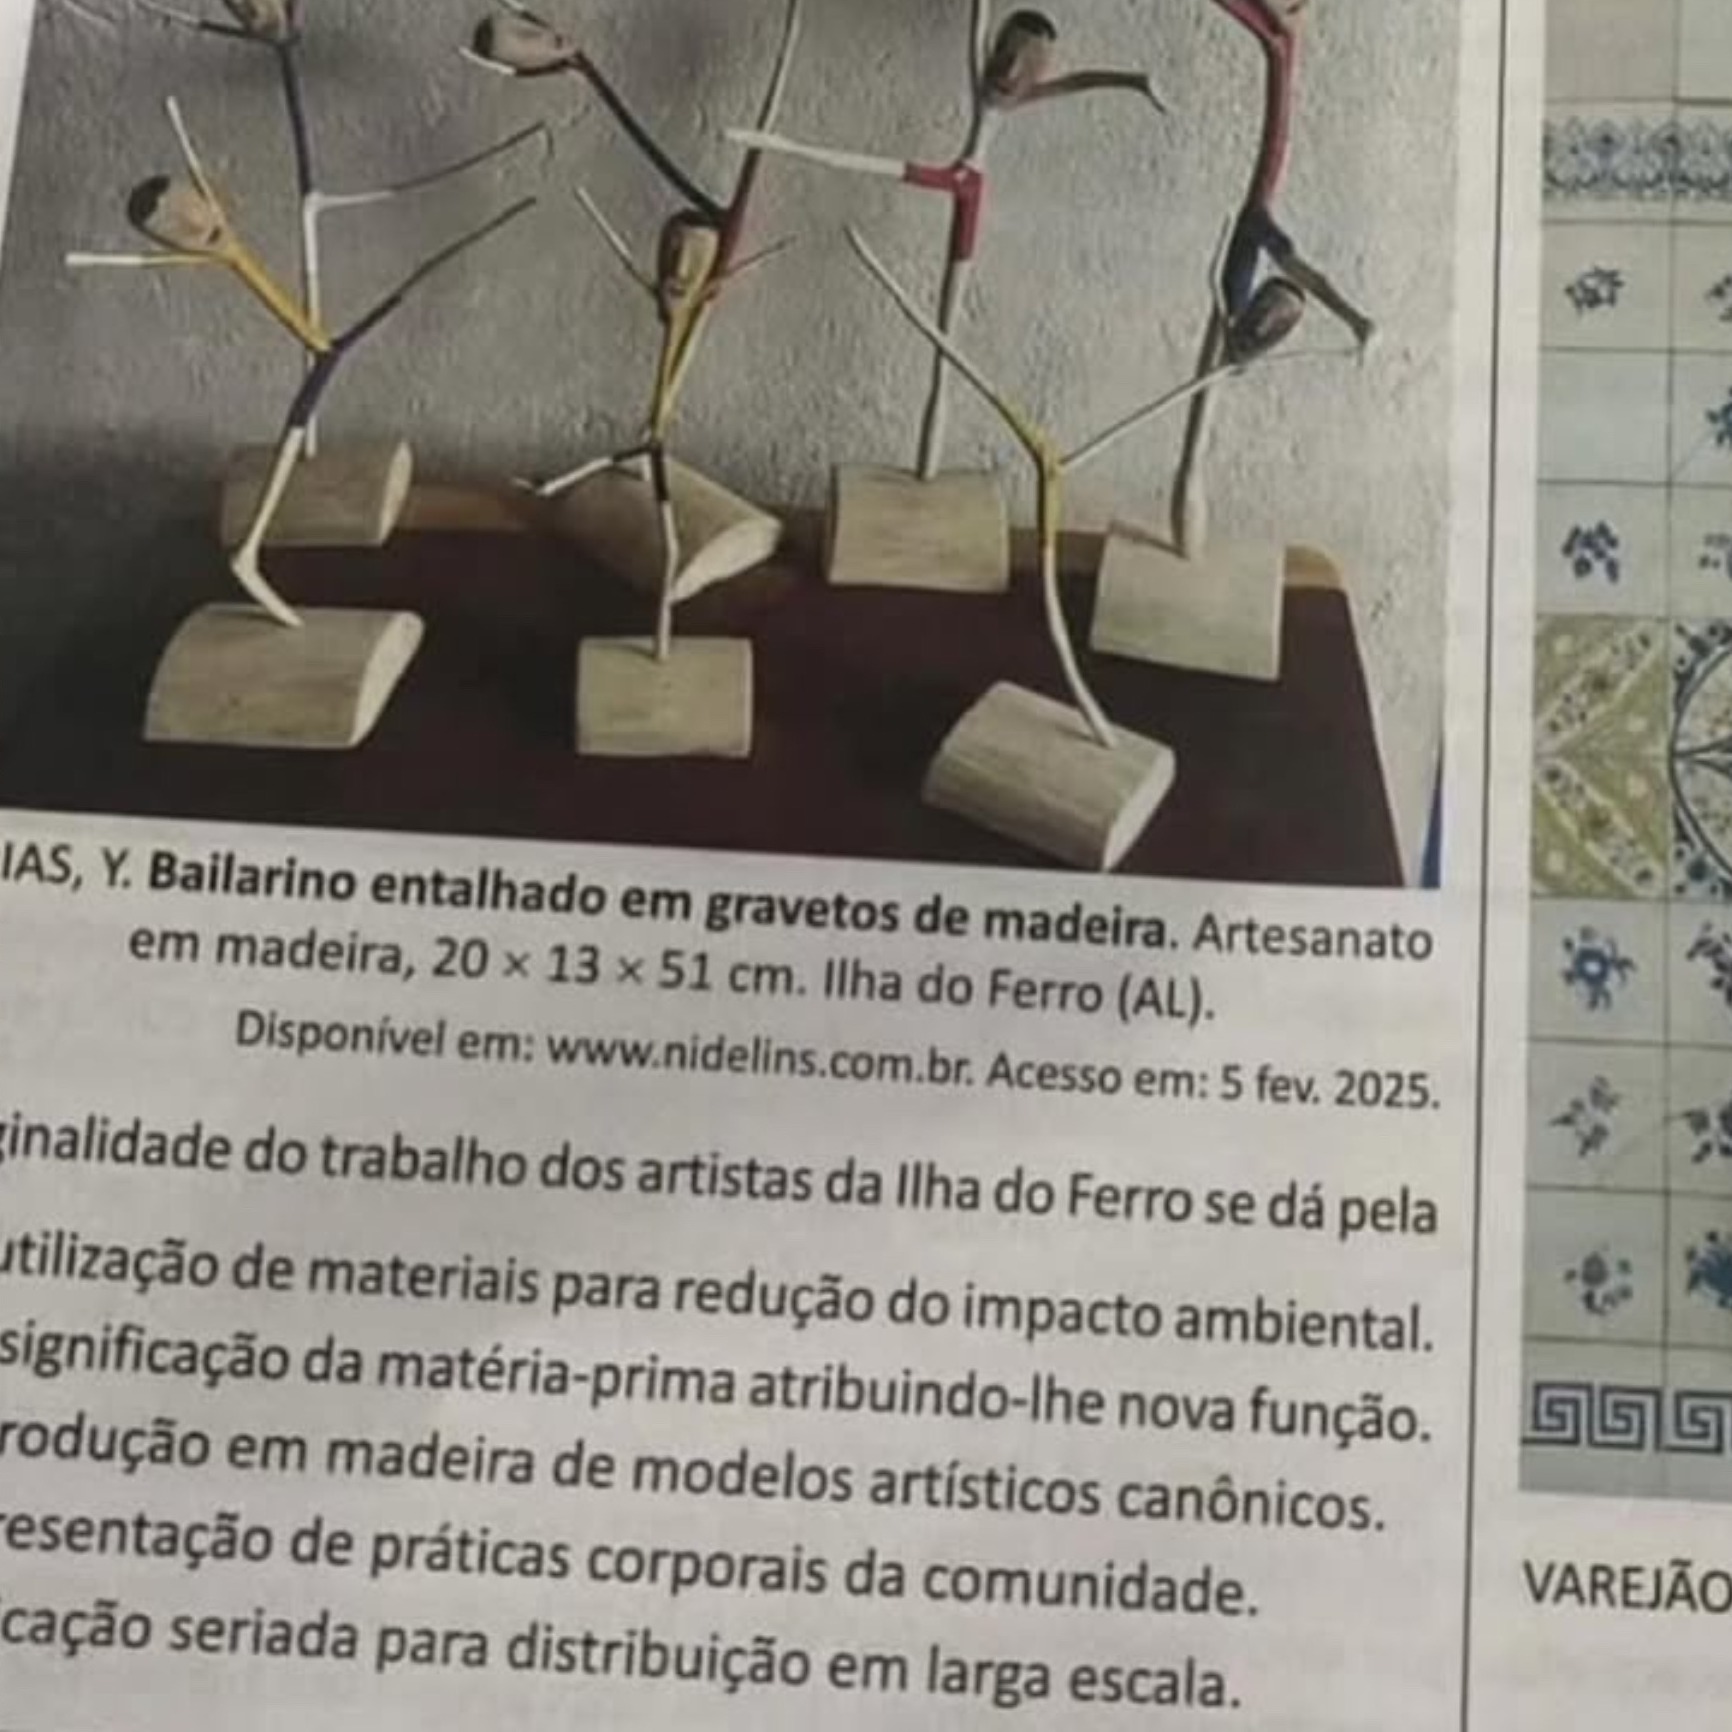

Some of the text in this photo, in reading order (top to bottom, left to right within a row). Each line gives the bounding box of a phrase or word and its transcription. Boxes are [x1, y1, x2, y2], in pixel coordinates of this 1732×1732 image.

[103, 848, 131, 889] Y.
[148, 851, 357, 901] Bailarino
[371, 868, 607, 916] entalhado
[620, 887, 692, 920] em
[705, 892, 899, 933] gravetos
[914, 894, 970, 936] de
[984, 903, 1178, 950] madeira.
[1192, 913, 1433, 961] Artesanato
[128, 928, 200, 962] em
[216, 928, 415, 982] madeira,
[432, 936, 489, 979] 20
[547, 944, 600, 985] 13
[658, 948, 711, 991] 51
[728, 962, 806, 996] cm.
[824, 958, 902, 1002] Ilha
[917, 963, 973, 1006] do
[989, 968, 1104, 1014] Ferro
[1118, 973, 1215, 1030] (AL).
[236, 1009, 1440, 1110] Disponível em: www.nidelins.com.br. Acesso em: 5 fev. 2025.
[244, 1124, 308, 1175] do
[320, 1132, 527, 1187] trabalho
[539, 1141, 625, 1192] dos
[637, 1151, 813, 1202] artistas
[825, 1156, 882, 1206] da
[897, 1161, 980, 1211] Ilha
[994, 1165, 1055, 1215] do
[1068, 1171, 1194, 1223] Ferro
[1204, 1190, 1256, 1226] se
[1268, 1180, 1324, 1230] dá
[1338, 1185, 1438, 1243] pela
[232, 1241, 295, 1291] de
[308, 1254, 539, 1305] materiais
[552, 1271, 660, 1317] para
[674, 1266, 875, 1330] redução
[887, 1276, 951, 1327] do
[964, 1281, 1162, 1343] impacto
[1175, 1295, 1433, 1353] ambiental.
[303, 1334, 363, 1384] da
[377, 1343, 735, 1409] matéria-prima
[749, 1363, 1105, 1425] atribuindo-lhe
[1119, 1392, 1235, 1432] nova
[1250, 1385, 1431, 1450] função.
[227, 1433, 307, 1472] em
[326, 1430, 535, 1485] madeira
[552, 1438, 615, 1489] de
[633, 1447, 853, 1502] modelos
[869, 1459, 1101, 1516] artísticos
[1117, 1473, 1386, 1532] canônicos.
[290, 1515, 354, 1566] de
[370, 1522, 570, 1579] práticas
[587, 1544, 827, 1597] corporais
[845, 1547, 905, 1598] da
[923, 1560, 1259, 1617] comunidade.
[169, 1607, 358, 1659] seriada
[375, 1626, 488, 1674] para
[507, 1620, 811, 1695] distribuição
[828, 1652, 908, 1692] em
[927, 1643, 1050, 1709] larga
[1068, 1656, 1241, 1709] escala.
